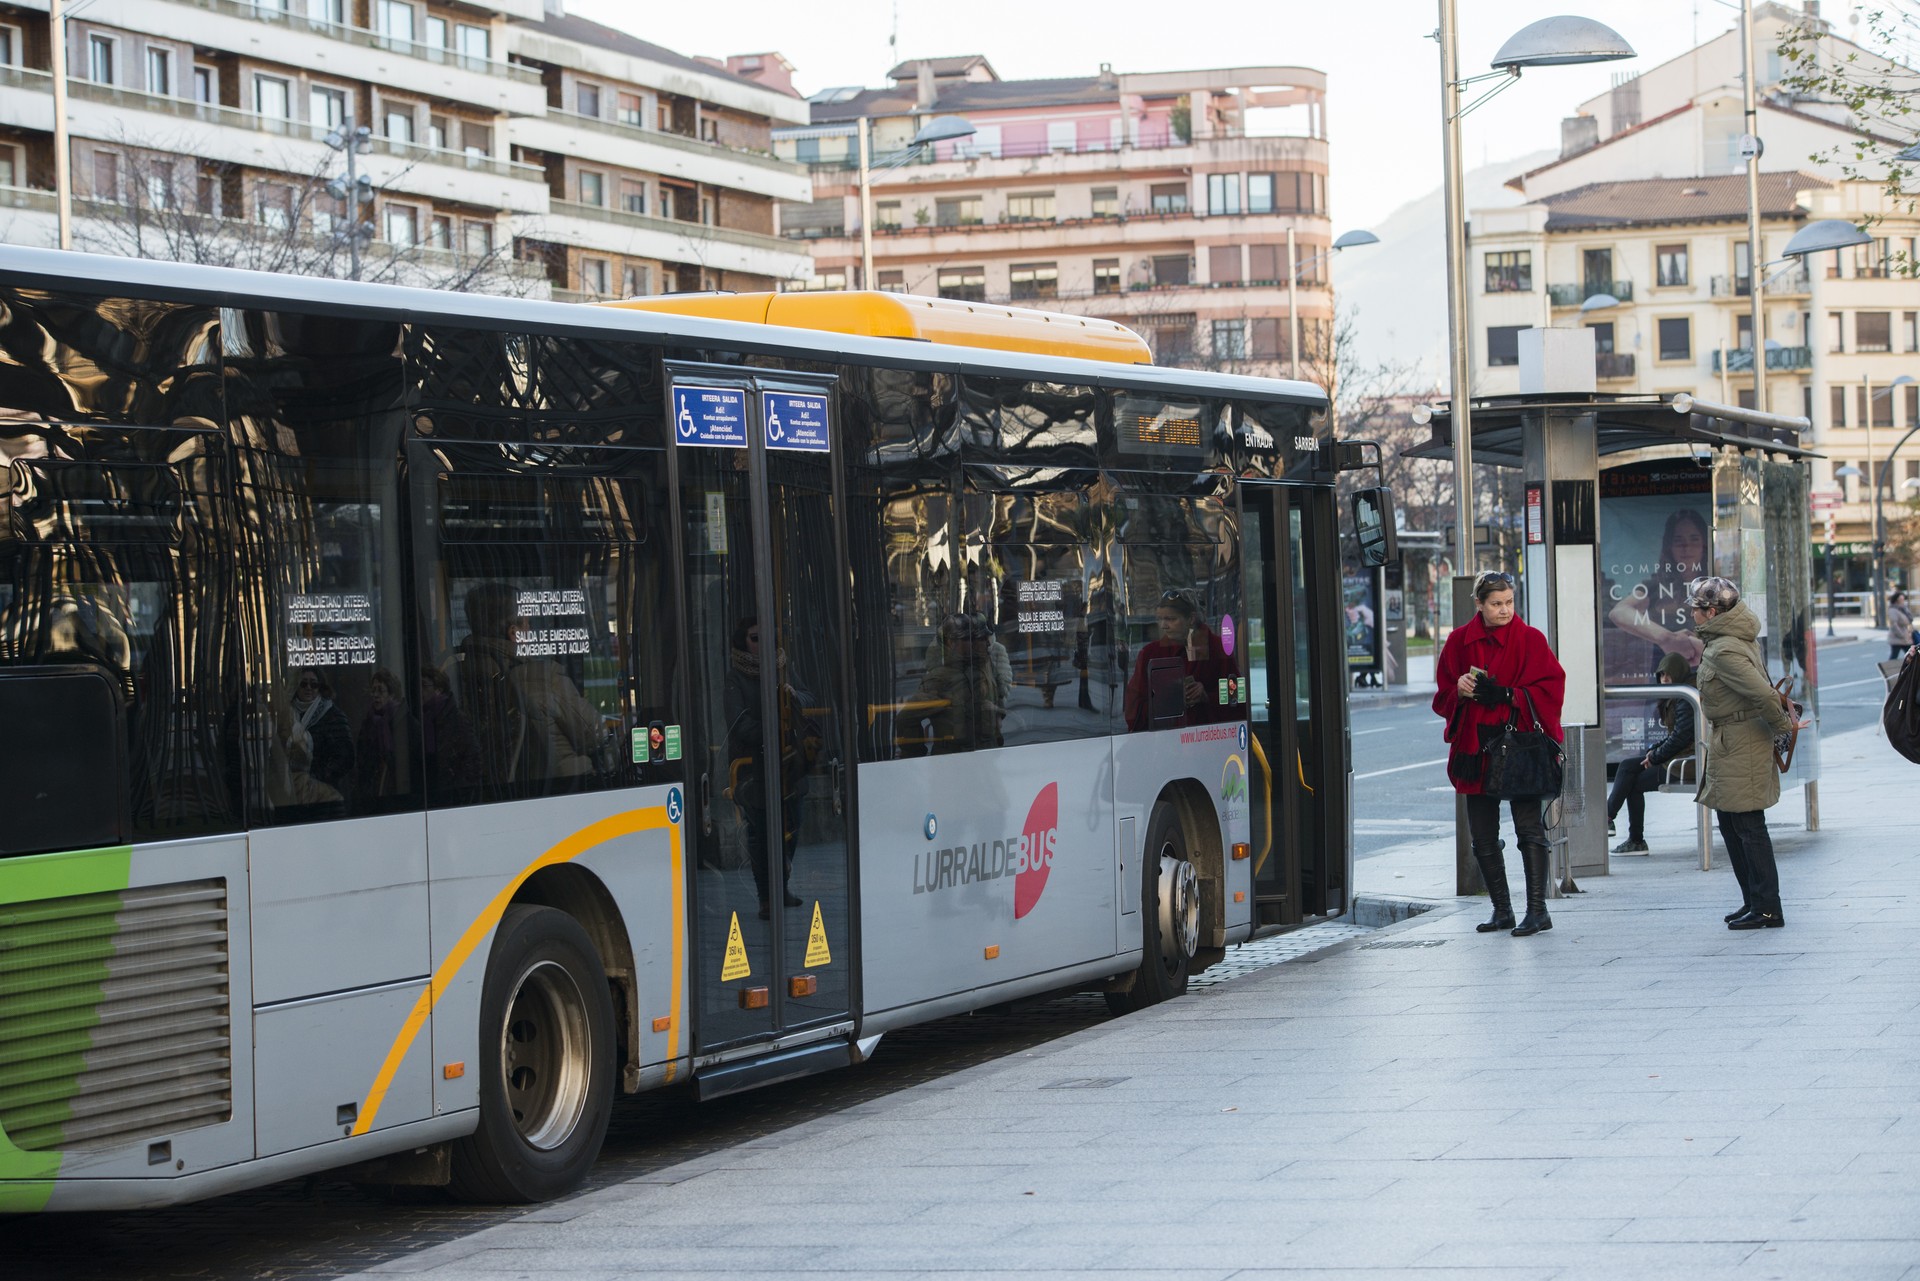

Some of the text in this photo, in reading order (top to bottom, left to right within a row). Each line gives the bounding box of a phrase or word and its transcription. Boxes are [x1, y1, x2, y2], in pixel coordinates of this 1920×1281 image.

[701, 394, 738, 404] IRTEERA SALIDA
[789, 400, 821, 409] IRTEERA SALIDA
[1244, 433, 1274, 449] ENTRADA
[1294, 436, 1320, 452] SARRERA
[1611, 562, 1702, 575] COMPROM
[288, 594, 370, 609] LARRIALDIETAKO IRTEERA
[516, 590, 585, 604] LARRIALDIETAKO IRTEERA
[1633, 608, 1687, 626] MIS
[515, 628, 590, 643] SALIDA DE EMERGENCIA
[287, 636, 376, 652] SALIDA DE EMERGENCIA
[1180, 725, 1238, 745] www.lurraldebus.net
[912, 827, 1058, 895] LURRALDEBUS
